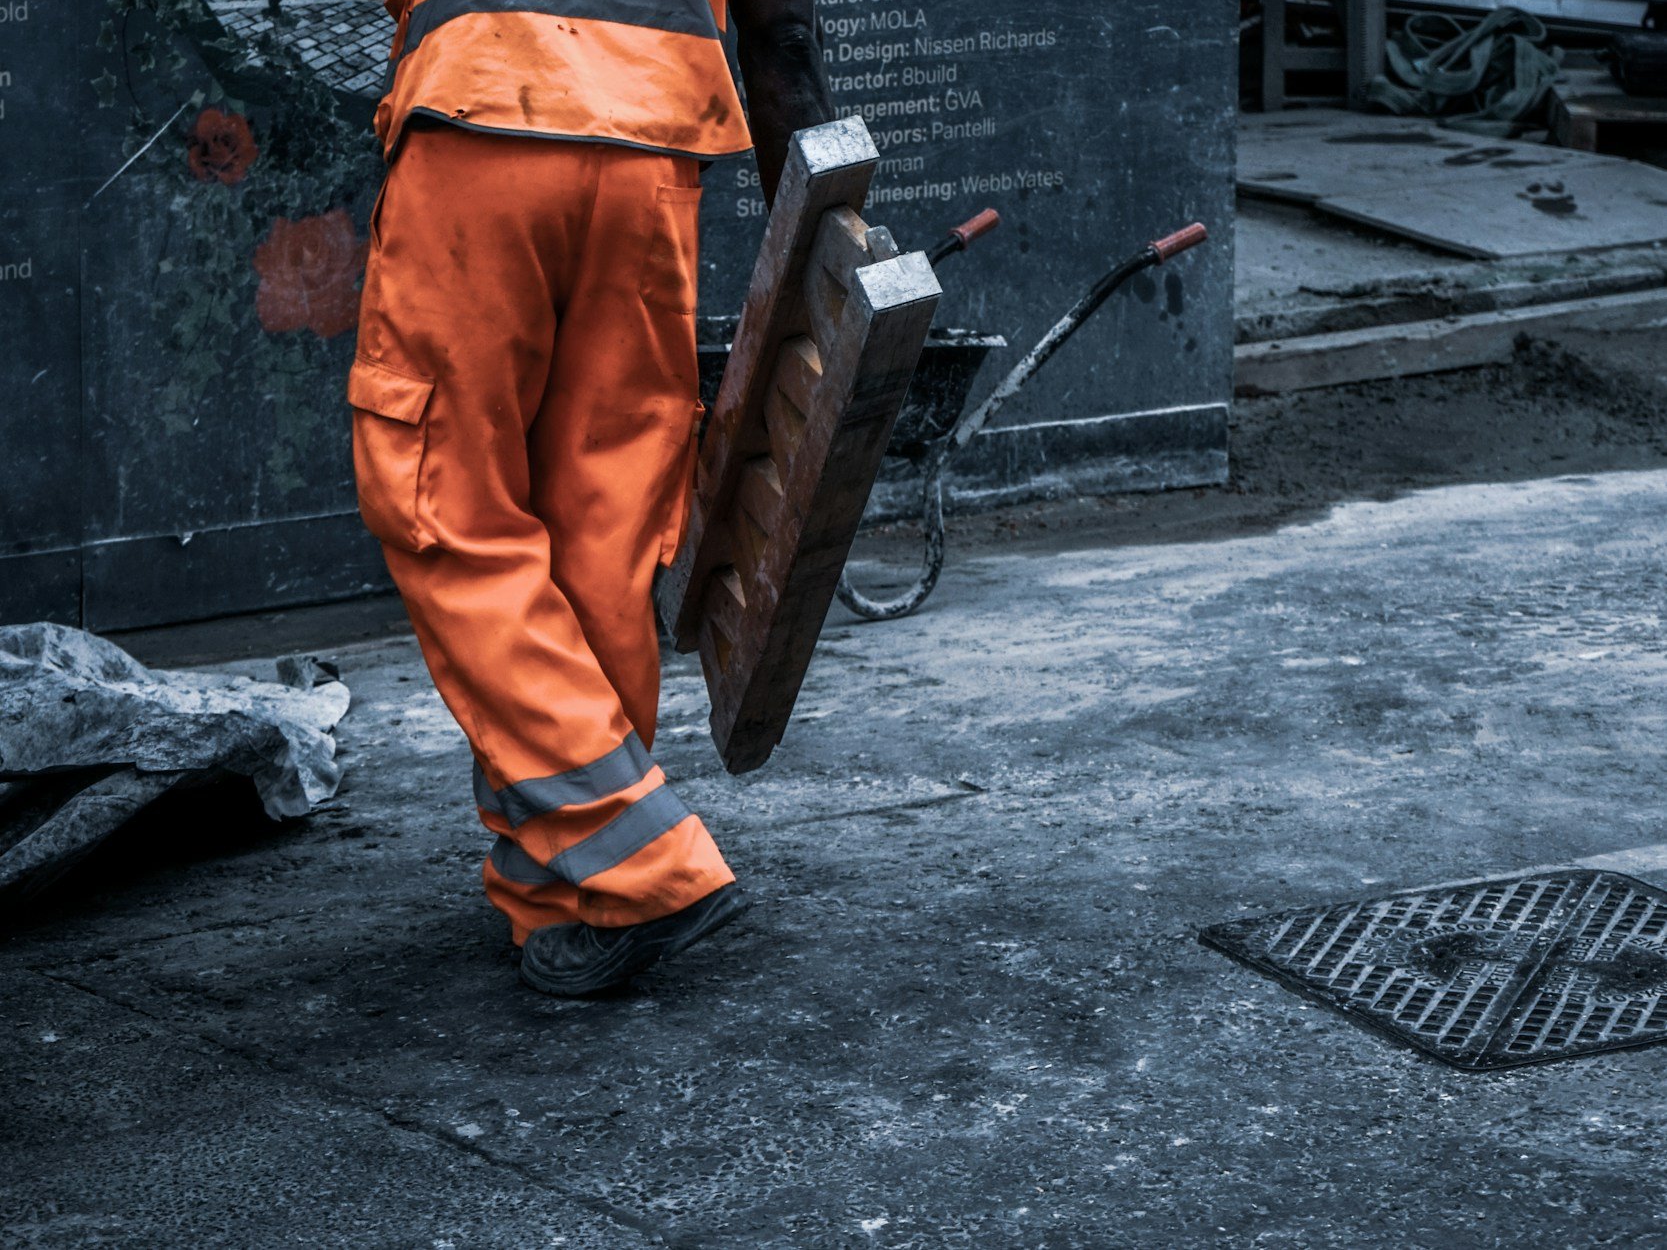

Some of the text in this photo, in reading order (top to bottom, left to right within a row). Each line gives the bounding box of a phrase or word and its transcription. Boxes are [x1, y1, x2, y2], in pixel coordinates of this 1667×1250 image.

[870, 9, 927, 31] MOLA
[838, 41, 909, 63] Design:
[914, 36, 975, 55] Nissen
[980, 28, 1056, 51] Richards
[902, 63, 957, 87] 8build
[834, 90, 983, 121] nagement: GVA
[932, 117, 996, 141] Pantelli
[961, 172, 1012, 195] Webb
[1016, 169, 1064, 191] Yates
